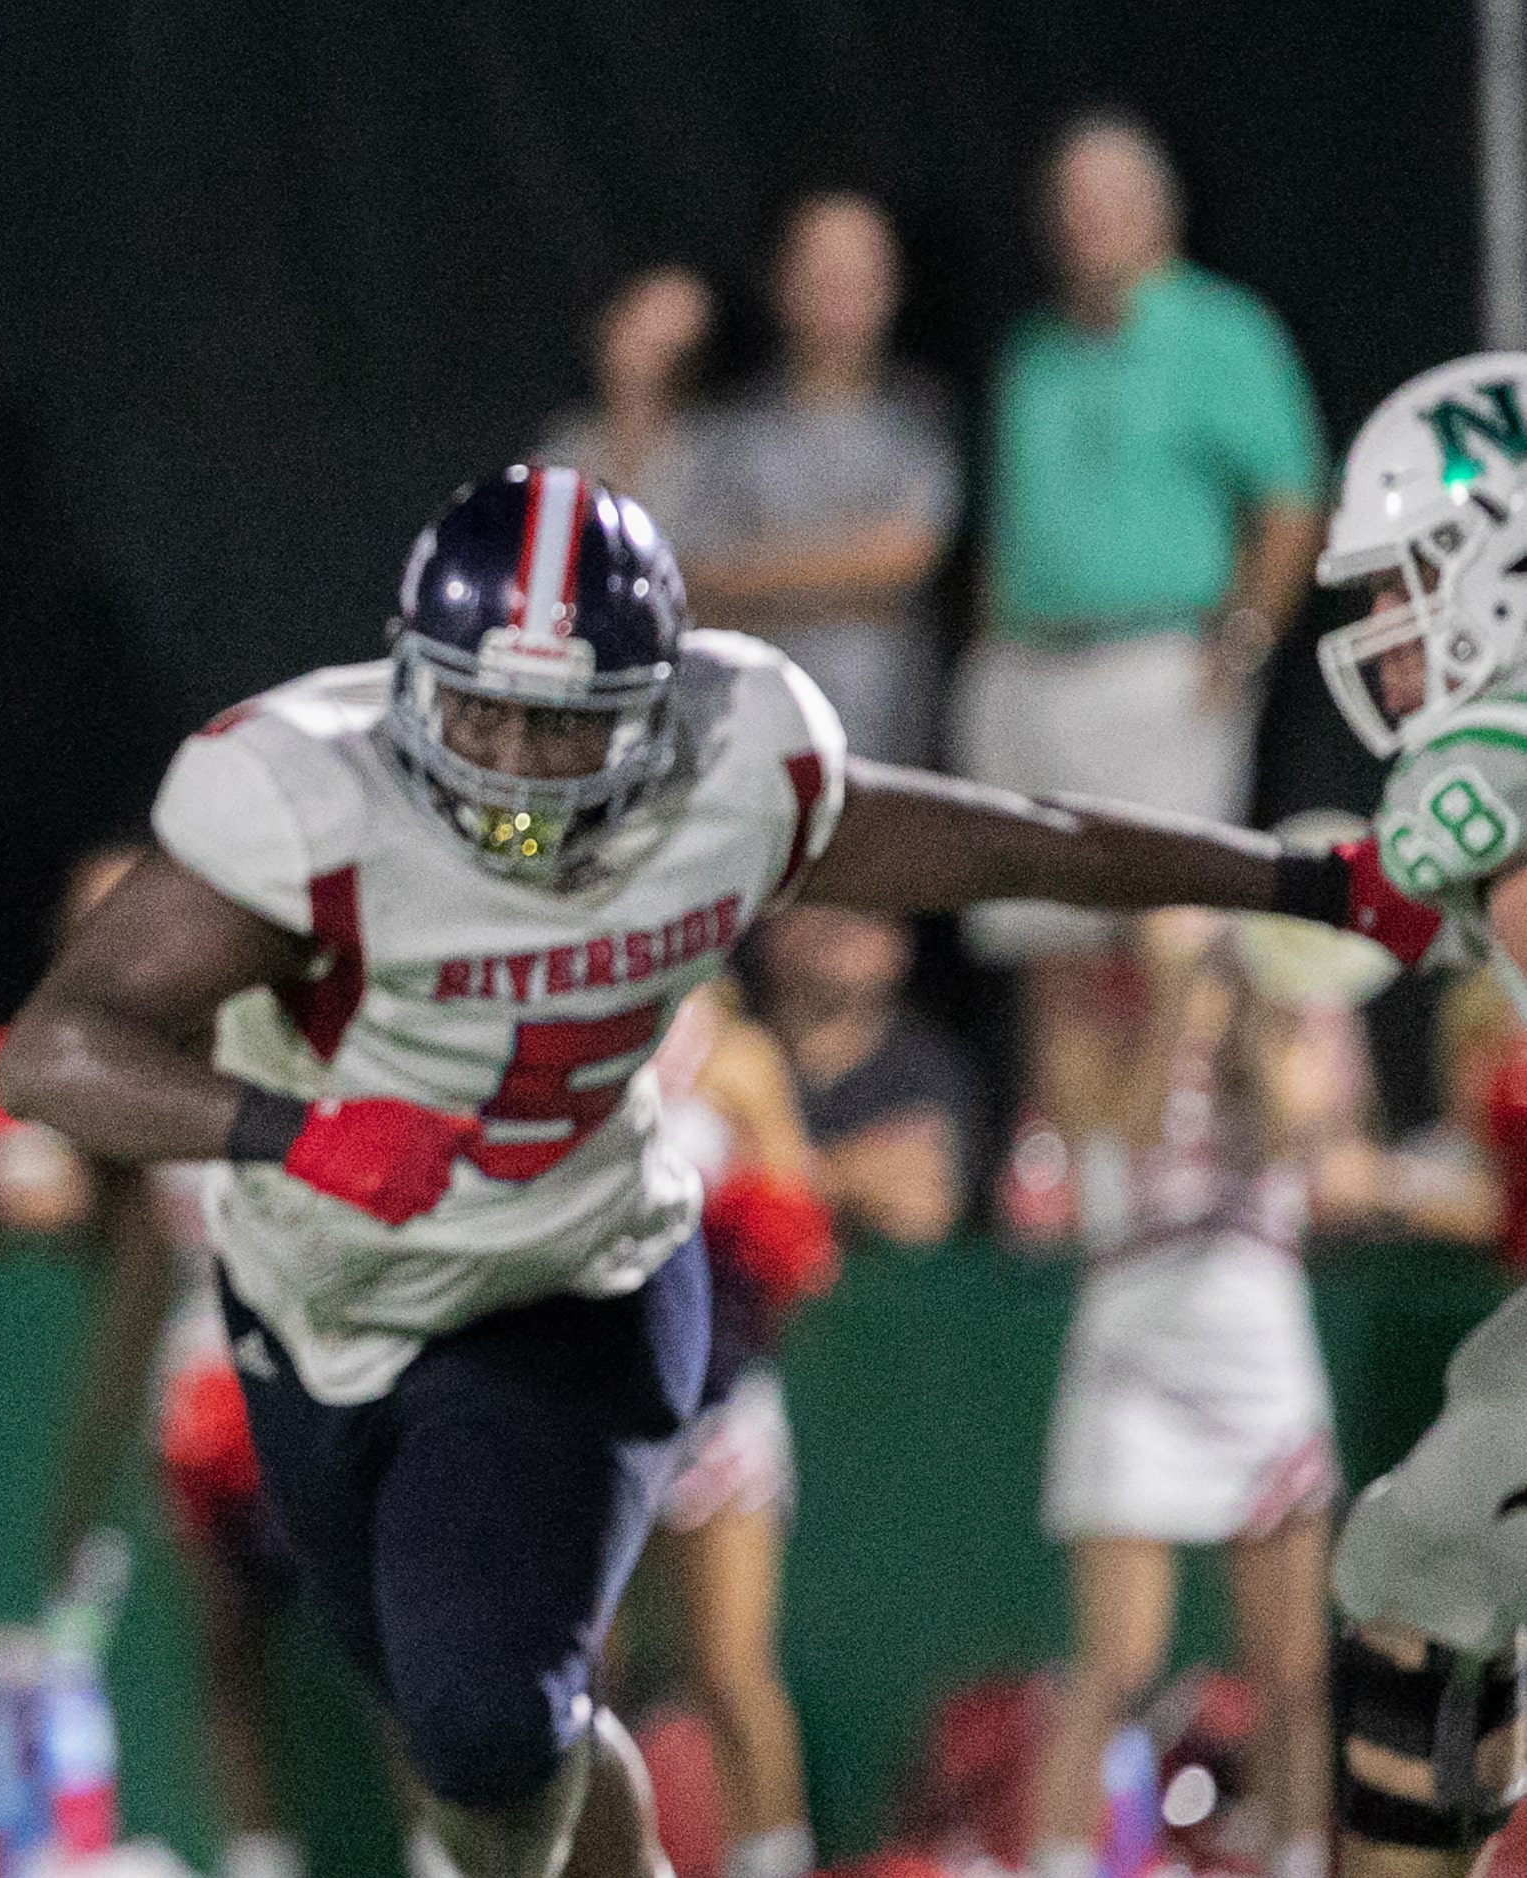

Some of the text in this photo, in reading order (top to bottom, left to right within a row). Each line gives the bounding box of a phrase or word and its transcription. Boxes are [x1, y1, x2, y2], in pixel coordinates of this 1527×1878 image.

[1415, 380, 1527, 487] N
[435, 893, 740, 1003] RIVERSIDE
[466, 1001, 661, 1182] 5
